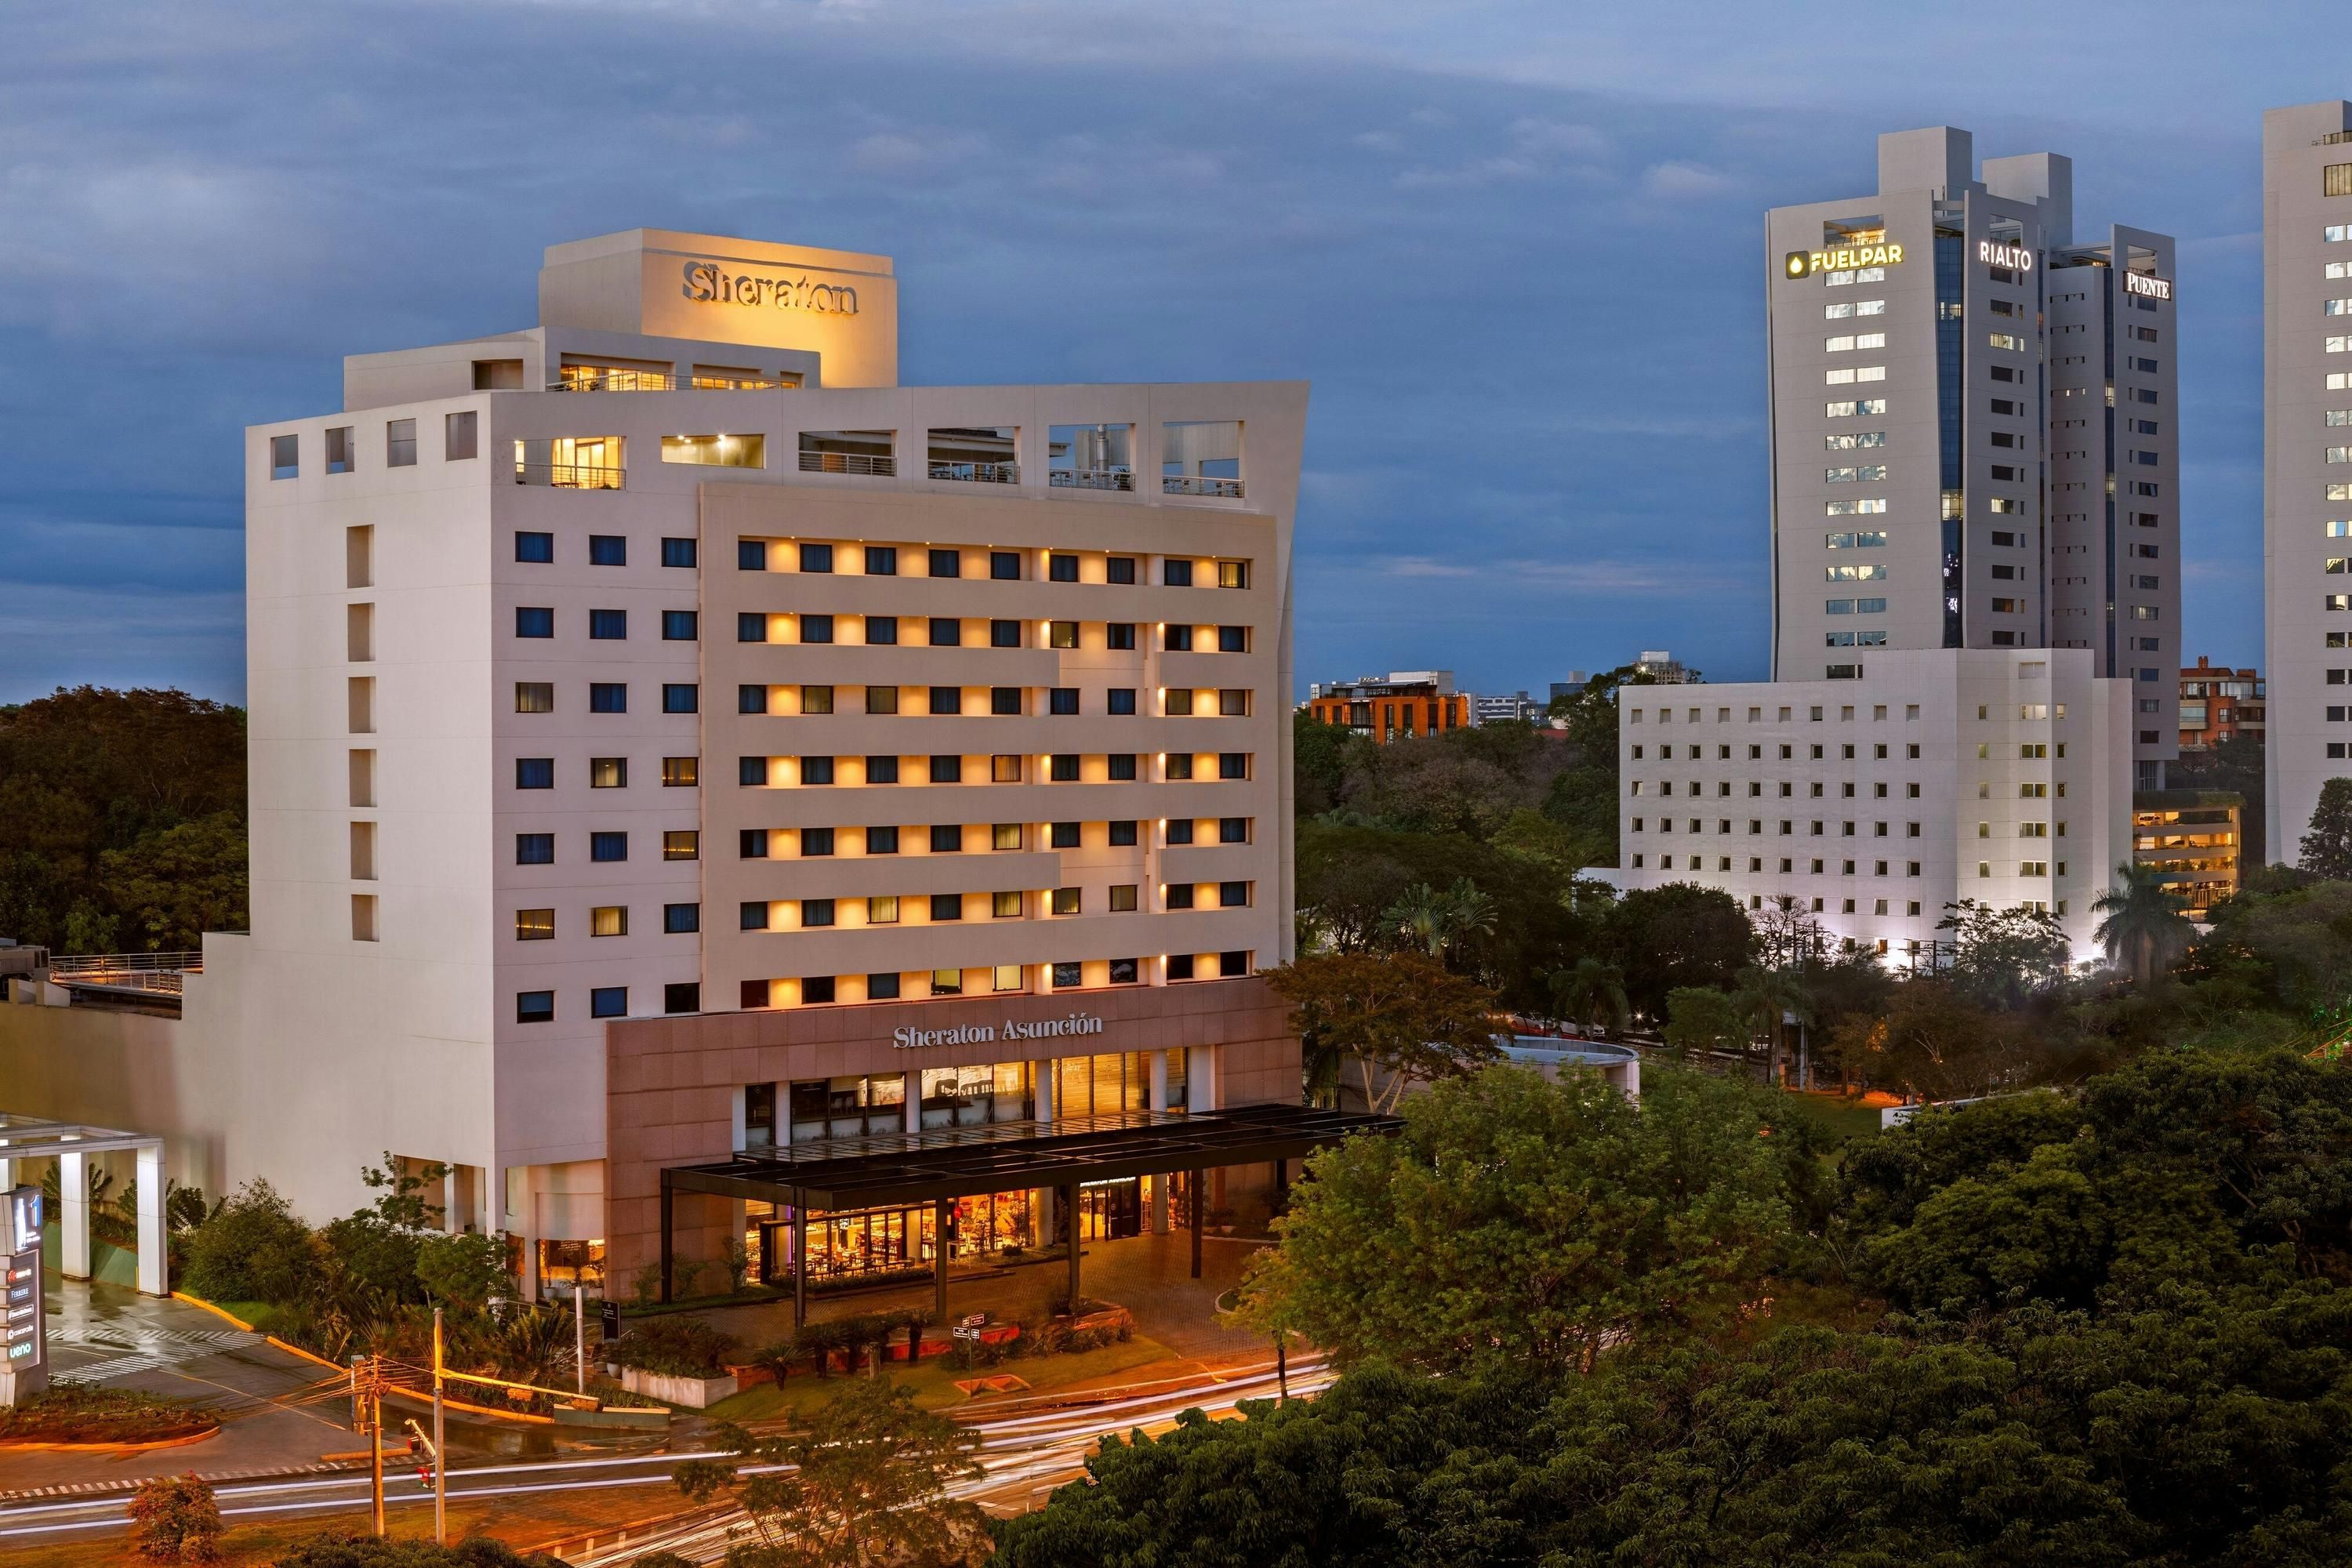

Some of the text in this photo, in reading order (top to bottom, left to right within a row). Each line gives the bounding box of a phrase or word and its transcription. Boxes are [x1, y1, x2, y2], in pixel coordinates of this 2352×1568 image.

[1811, 245, 1903, 272] FUELPAR
[1980, 241, 2031, 270] RIALTO
[683, 261, 858, 314] Sheraton
[2127, 272, 2169, 299] PUENTE
[893, 1012, 1102, 1048] Sheraton Asunción
[9, 1343, 31, 1358] ueno
